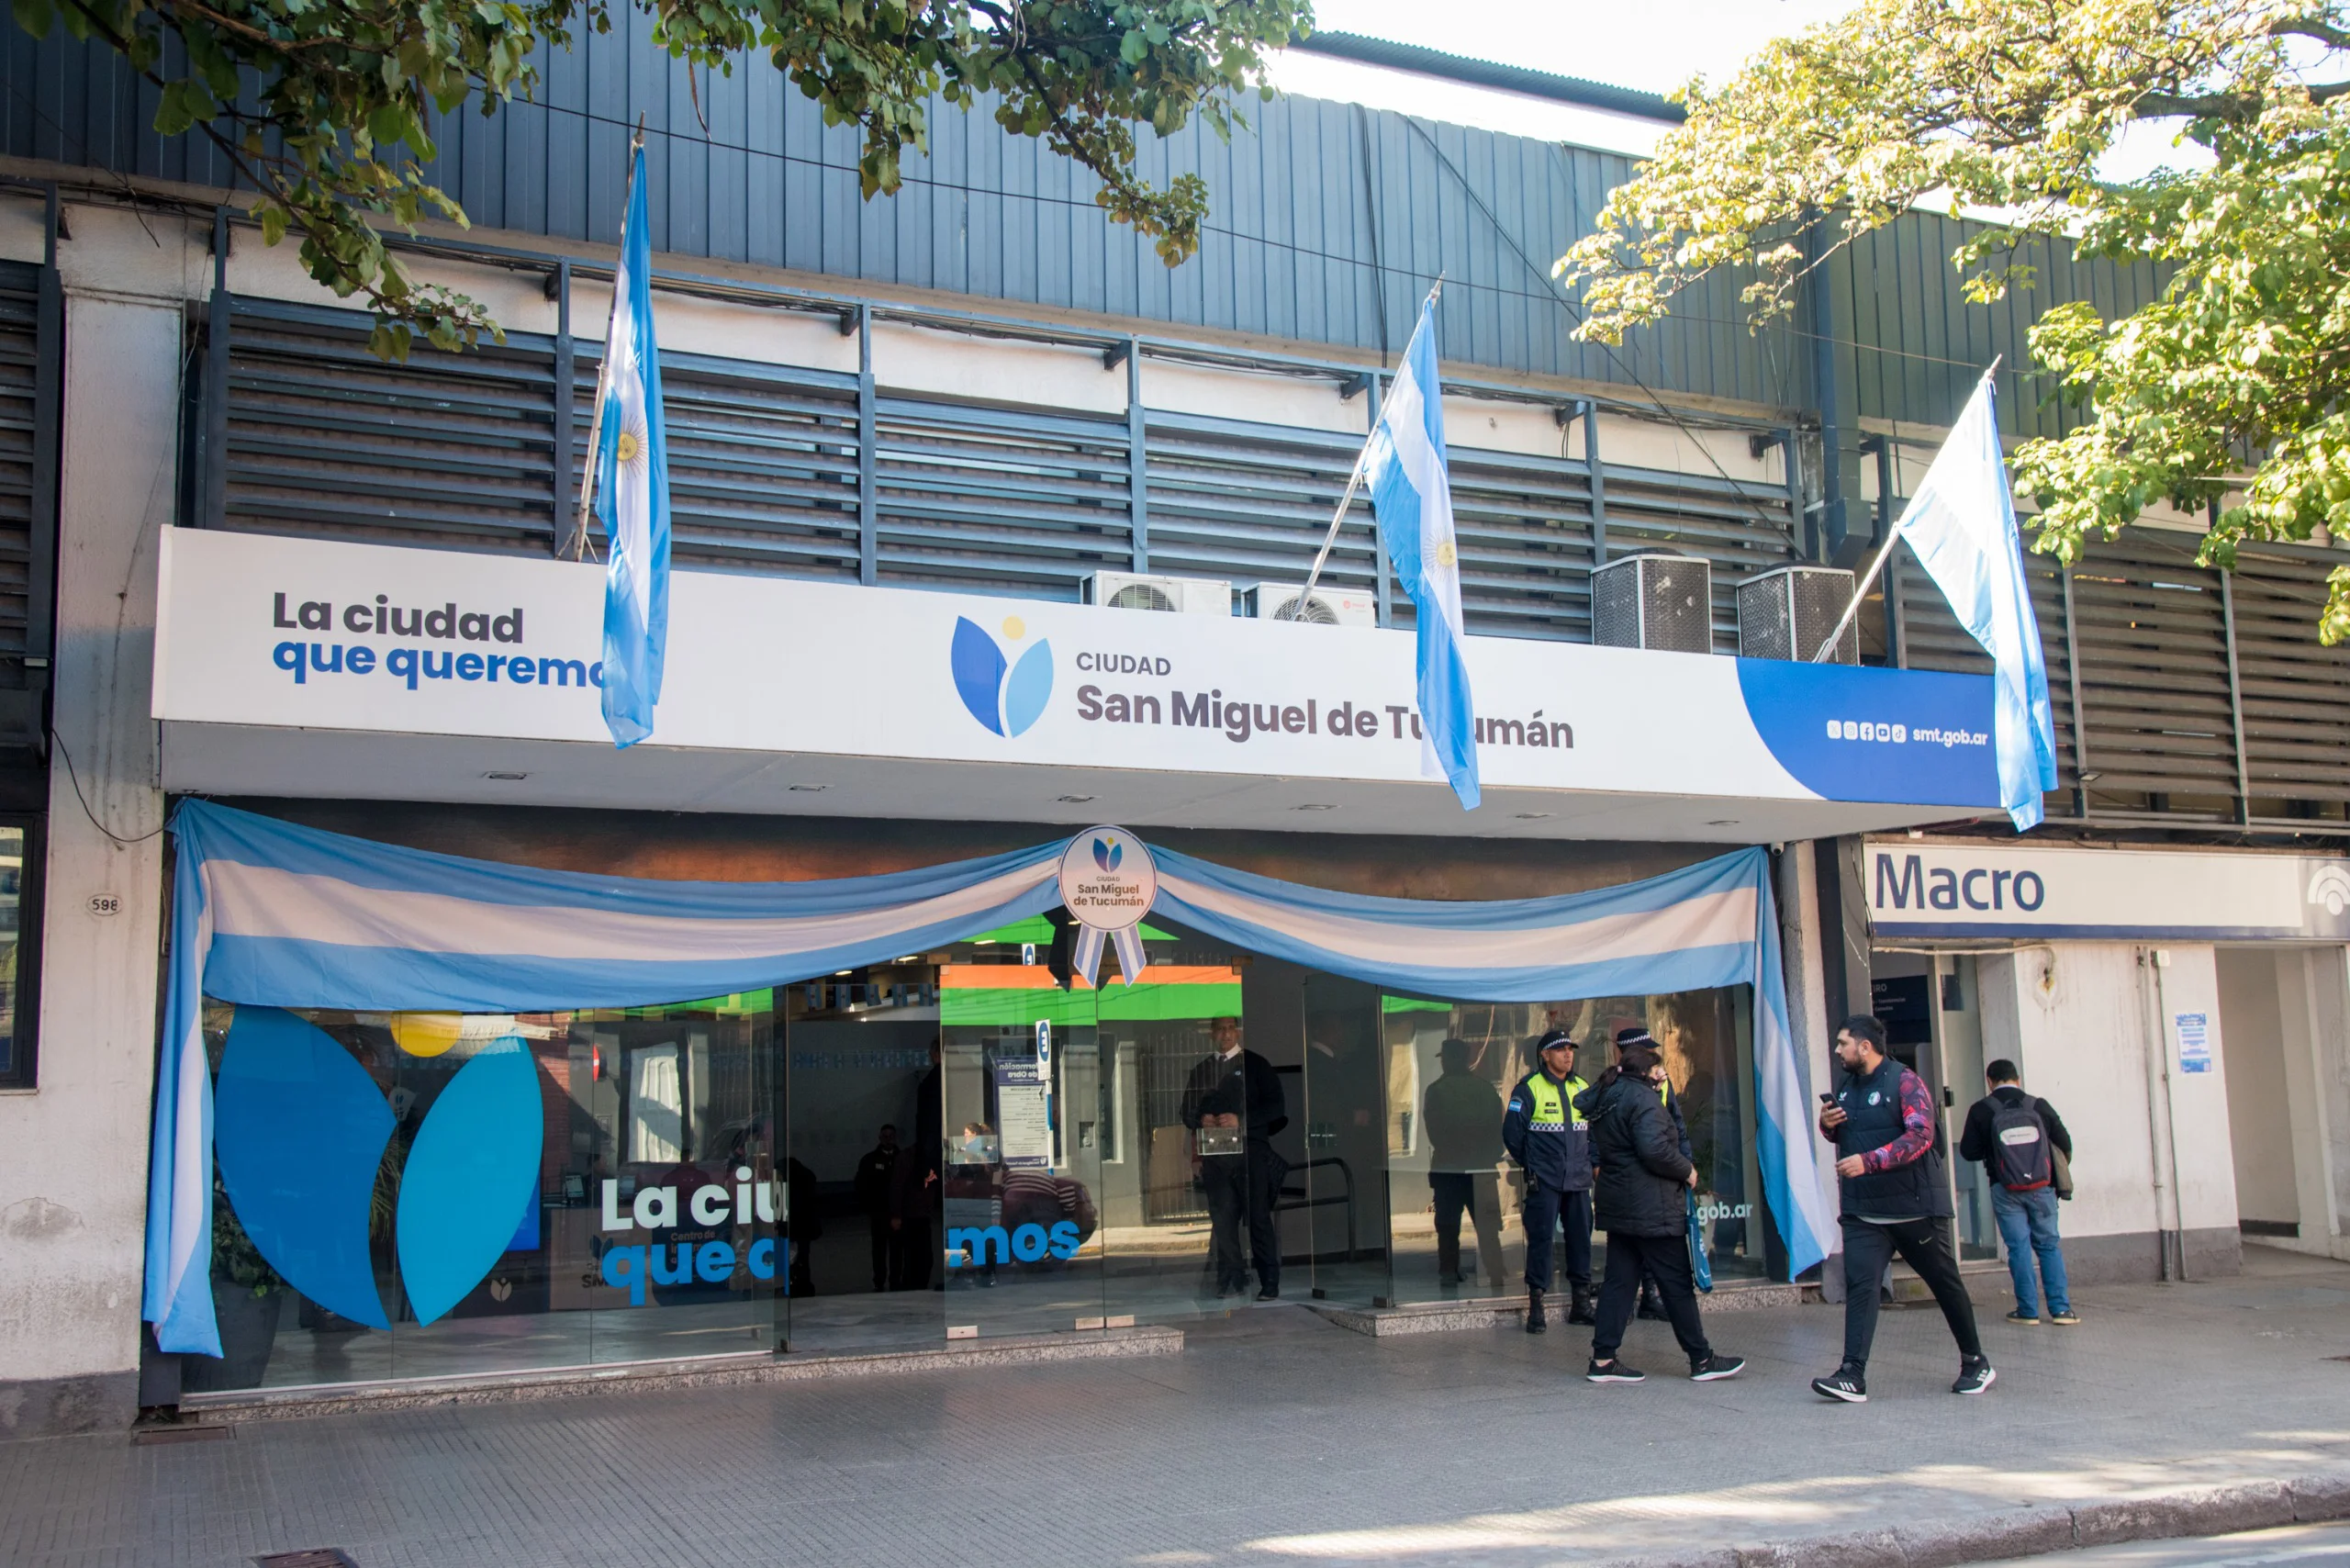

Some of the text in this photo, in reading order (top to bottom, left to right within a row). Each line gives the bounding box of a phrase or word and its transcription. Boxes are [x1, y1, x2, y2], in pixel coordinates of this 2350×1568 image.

[274, 592, 523, 644] La ciudad
[273, 641, 604, 690] que querem
[1076, 652, 1171, 677] CIUDAD
[1077, 684, 1161, 724] San
[1171, 689, 1317, 743] Miguel
[1326, 700, 1379, 738] de
[1912, 728, 1988, 748] smt.gob.ar
[1073, 896, 1145, 906] de Tucumán
[1078, 884, 1139, 897] San Miguel
[1875, 853, 2044, 912] Macro
[92, 899, 118, 912] 598
[601, 1179, 677, 1231] La
[670, 1230, 716, 1242] Centro de
[601, 1240, 736, 1306] que
